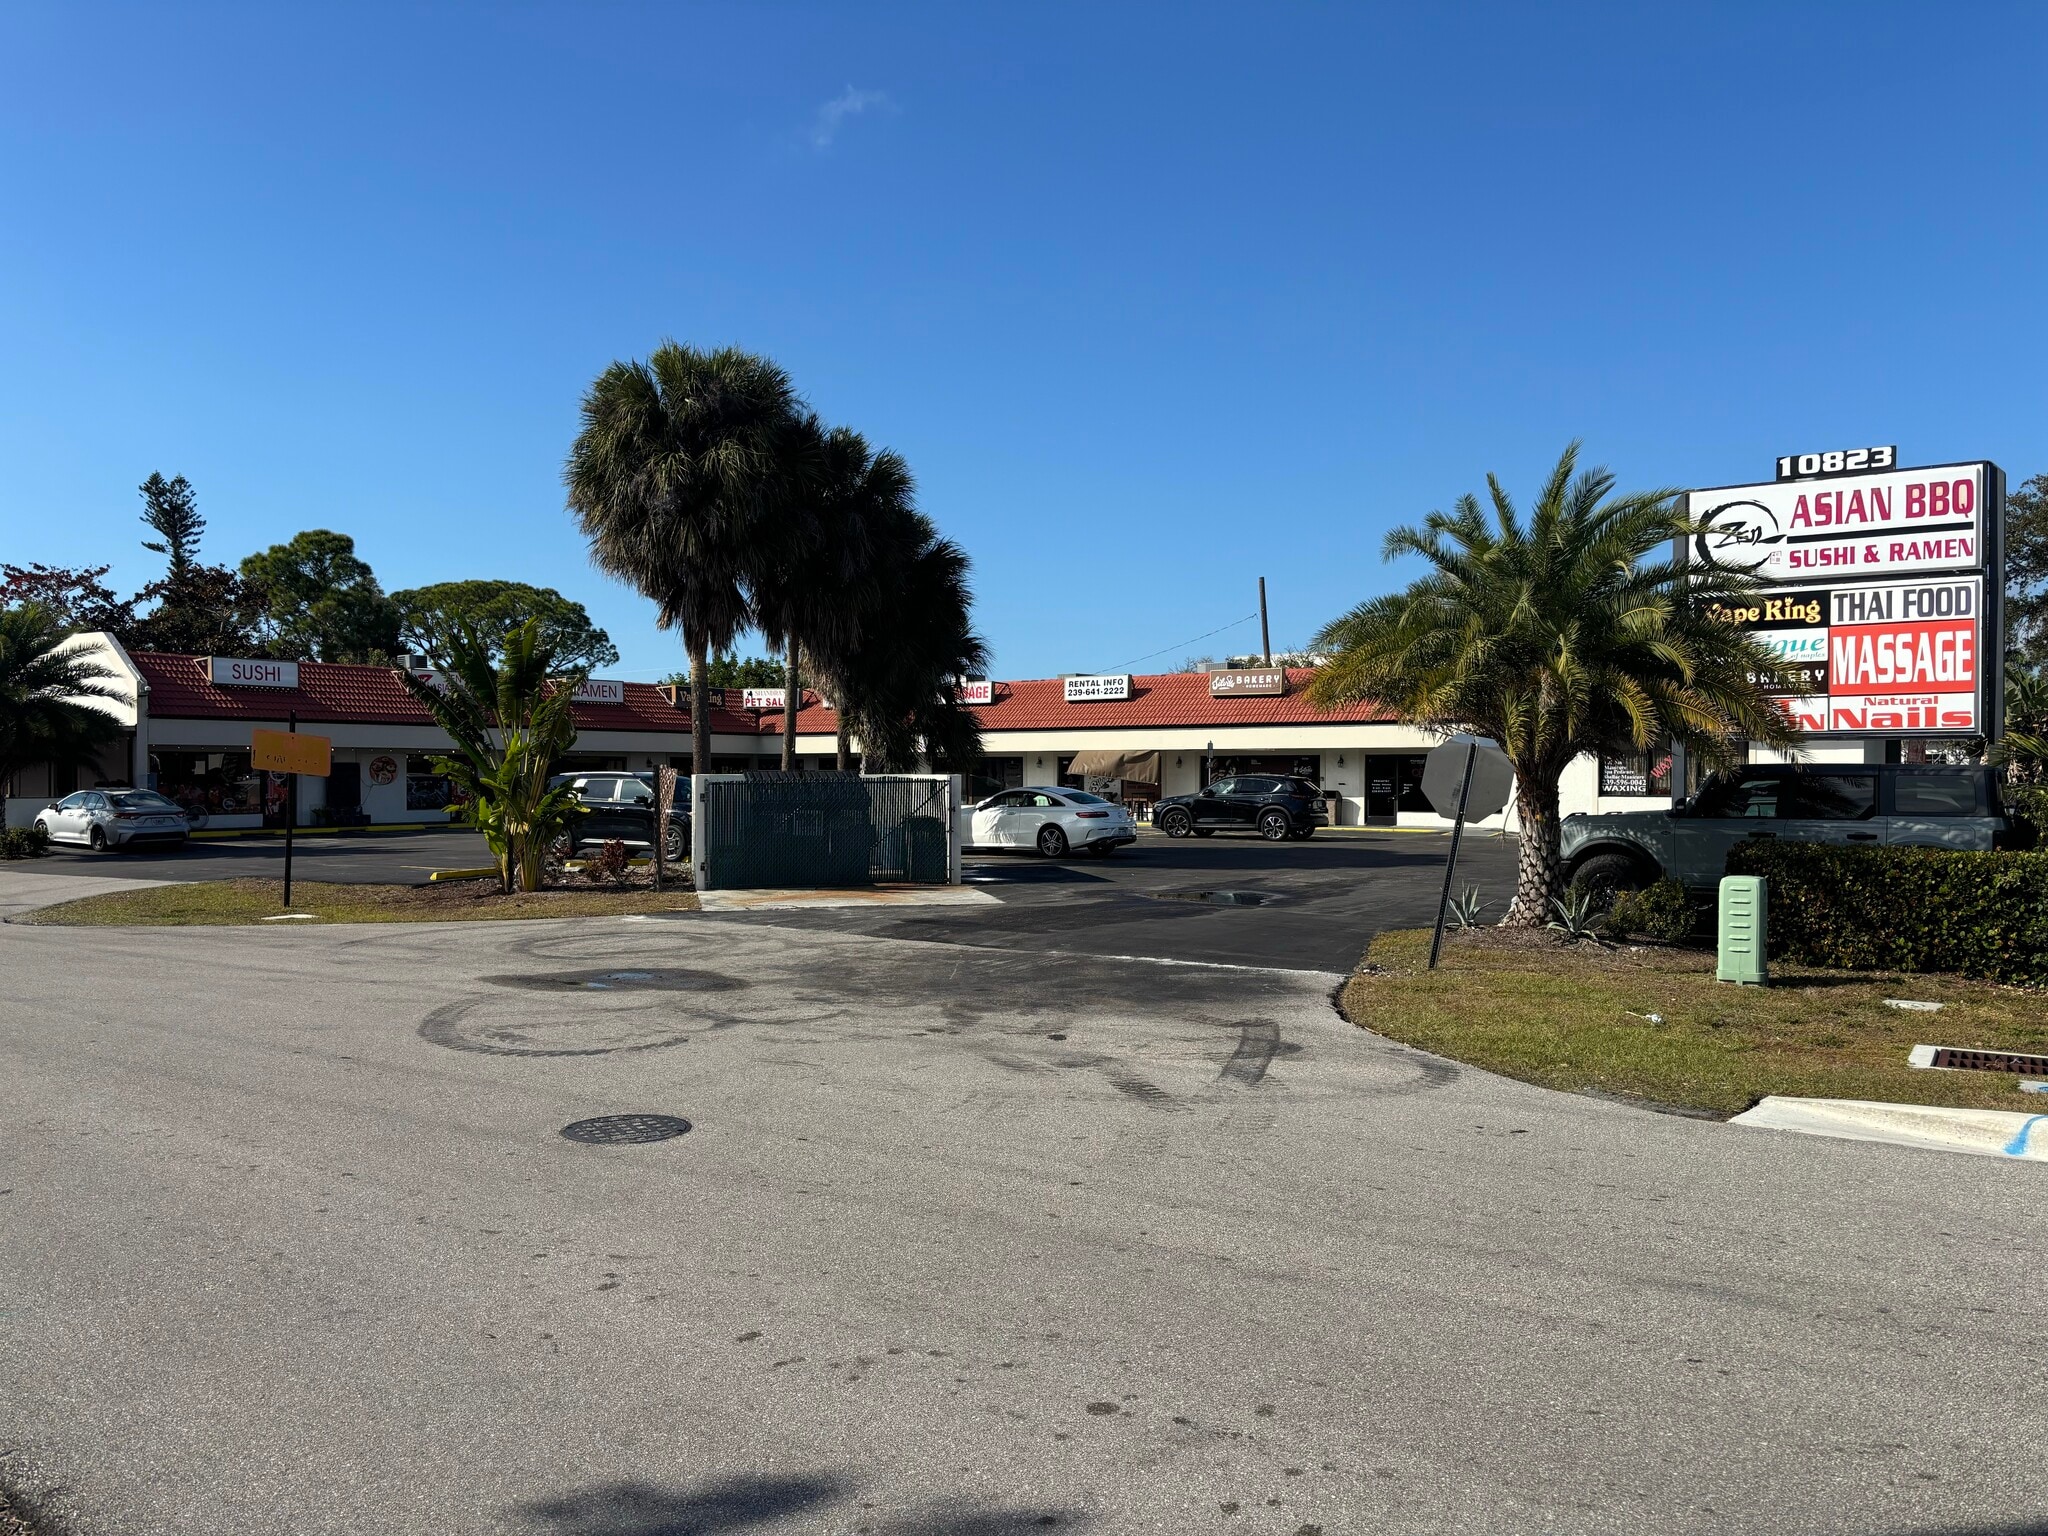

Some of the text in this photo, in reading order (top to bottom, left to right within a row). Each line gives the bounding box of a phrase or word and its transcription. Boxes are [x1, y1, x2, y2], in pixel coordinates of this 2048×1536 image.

[1779, 446, 1892, 477] 10823
[1789, 479, 1974, 529] ASIAN BBQ
[1789, 546, 1855, 569] SUSHI
[1864, 544, 1880, 564] &
[1889, 538, 1974, 562] RAMEN
[1764, 598, 1821, 623] King
[1833, 586, 1972, 622] THAI FOOD
[1832, 630, 1972, 685] MASSAGE
[232, 664, 281, 681] SUSHI
[1068, 678, 1124, 688] RENTAL INFO
[1236, 674, 1280, 684] BAKERY
[745, 698, 763, 706] PET
[1864, 696, 1939, 706] Natural
[1832, 706, 1973, 729] Nails
